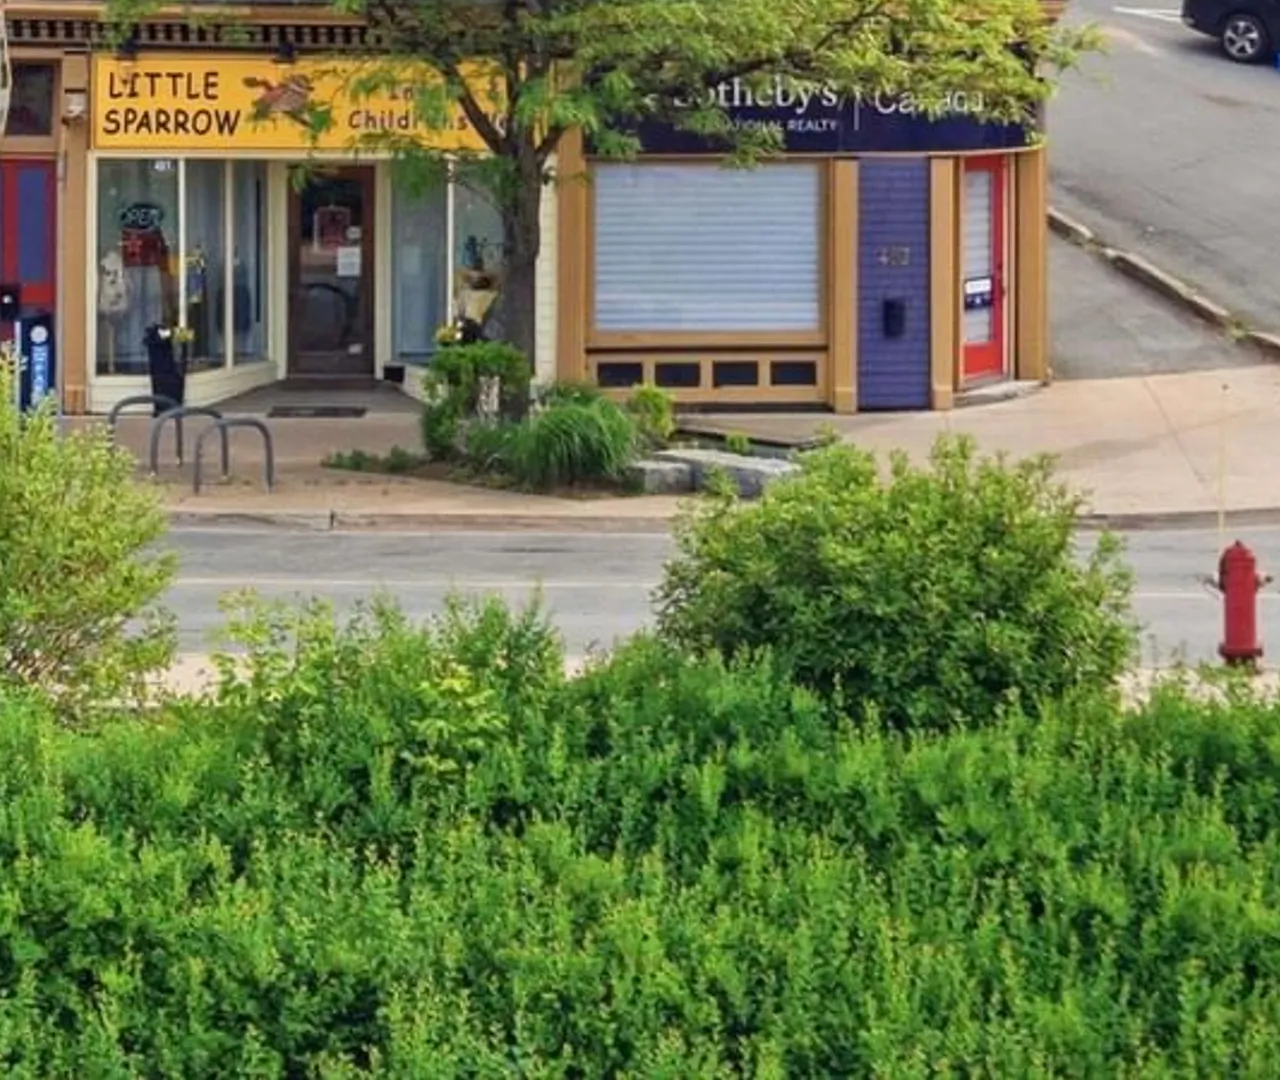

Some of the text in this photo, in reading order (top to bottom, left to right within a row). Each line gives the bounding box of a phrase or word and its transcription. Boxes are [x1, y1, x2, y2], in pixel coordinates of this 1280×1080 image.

[109, 72, 219, 100] LITTLE
[874, 87, 984, 114] Caada
[103, 108, 241, 135] SPARROW
[787, 120, 837, 131] REALTY
[121, 208, 160, 225] OPEN
